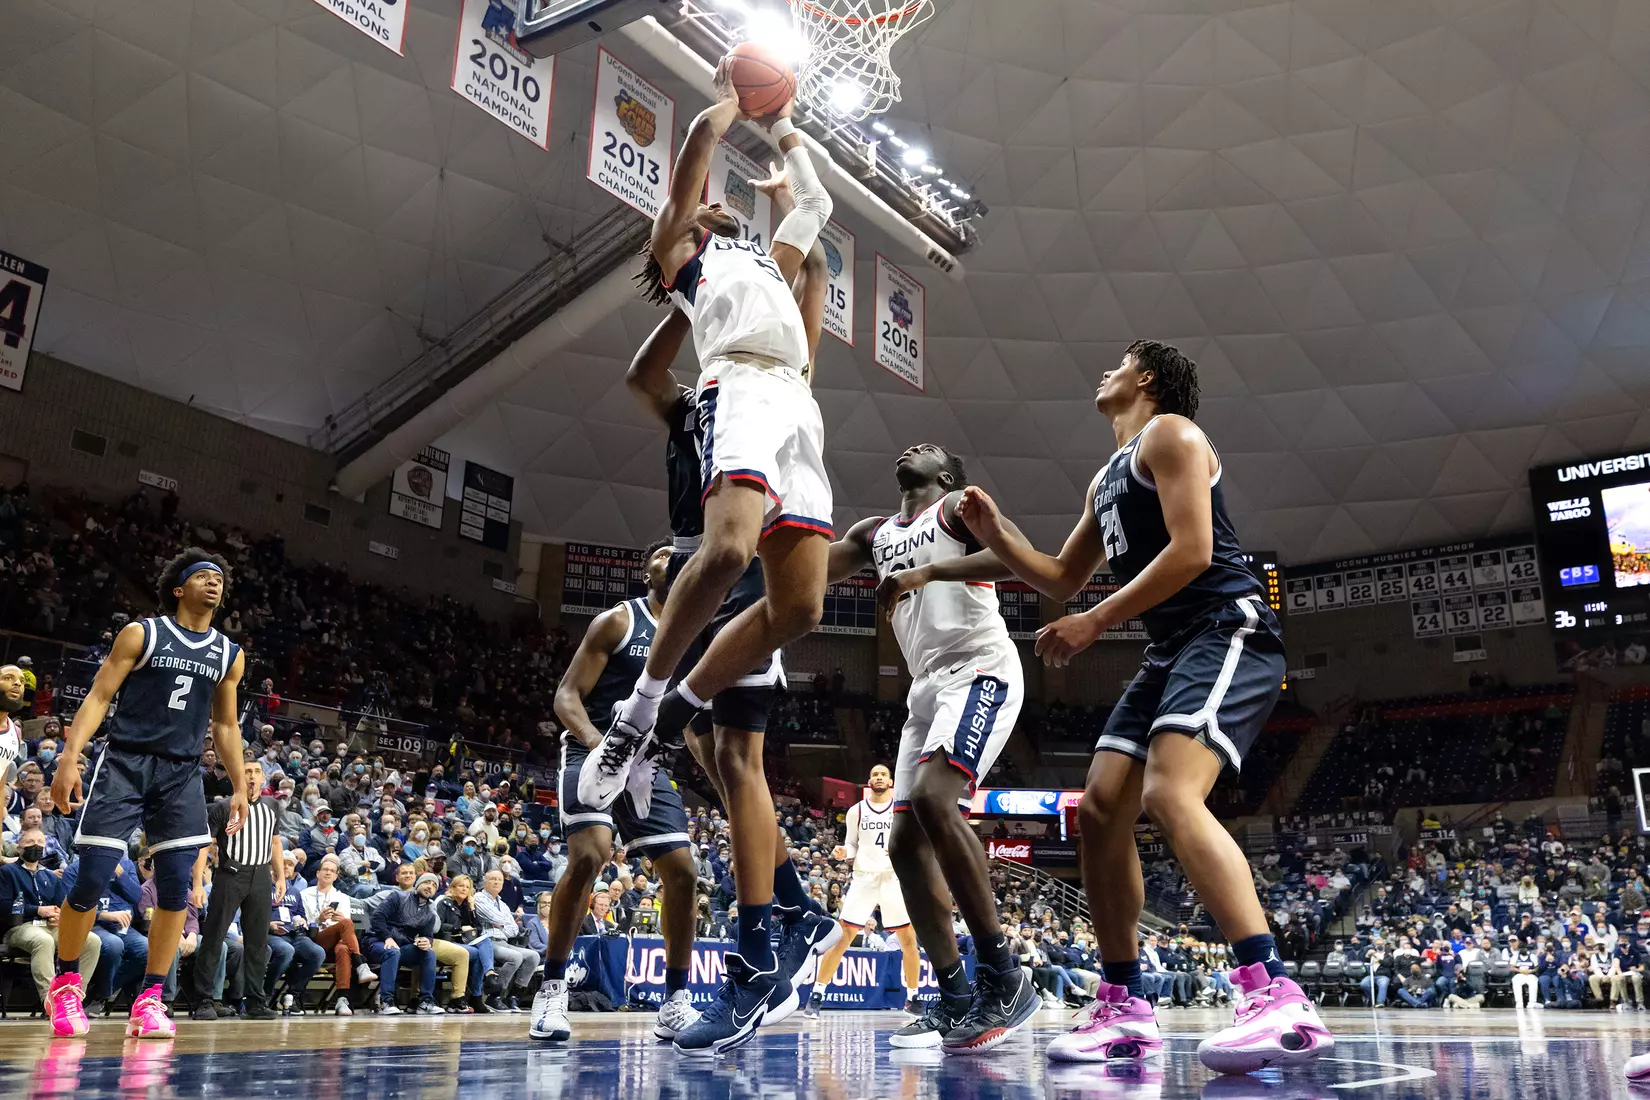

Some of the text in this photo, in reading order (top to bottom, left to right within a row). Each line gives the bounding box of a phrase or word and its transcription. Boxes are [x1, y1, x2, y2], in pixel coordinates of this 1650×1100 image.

[469, 38, 541, 103] 2010
[606, 55, 669, 107] UConn Women's
[472, 70, 535, 120] NATIONAL
[617, 75, 657, 109] Basketball
[464, 83, 538, 138] CHAMPIONS
[602, 131, 660, 186] 2013
[603, 159, 656, 201] NATIONAL
[598, 171, 660, 218] CHAMPIONS
[881, 320, 919, 359] 2016
[882, 343, 917, 371] NATIONAL
[879, 354, 919, 385] CHAMPIONS
[156, 476, 177, 489] 210
[1546, 496, 1591, 512] WELLS
[1549, 507, 1592, 522] FARGO
[568, 545, 589, 555] BIG
[595, 547, 627, 558] EAST
[873, 527, 935, 566] UCONN
[568, 554, 611, 565] REGULAR
[1335, 542, 1475, 569] UCONN HUSKIES OF HONOR
[588, 565, 604, 577] 1994
[610, 567, 626, 578] 1995
[1511, 562, 1536, 578] 42
[1559, 564, 1594, 580] CBS
[1413, 575, 1436, 591] 42
[1444, 571, 1468, 587] 44
[859, 588, 874, 598] 2011
[1326, 589, 1335, 603] 9
[1350, 584, 1372, 600] 22
[1380, 580, 1403, 596] 25
[1293, 593, 1307, 607] C
[1416, 614, 1440, 631] 24
[1451, 610, 1471, 627] 13
[1483, 606, 1506, 623] 22
[822, 626, 873, 634] BASKETBALL
[151, 656, 220, 682] GEORGETOWN
[65, 684, 88, 697] SEC
[167, 674, 194, 711] 2
[964, 679, 997, 760] HUSKIES
[378, 736, 422, 753] SEC 109
[874, 832, 884, 849] 4
[1349, 833, 1368, 844] 113
[1436, 829, 1456, 839] 114
[1148, 843, 1164, 853] 113
[624, 947, 728, 985] UCNN
